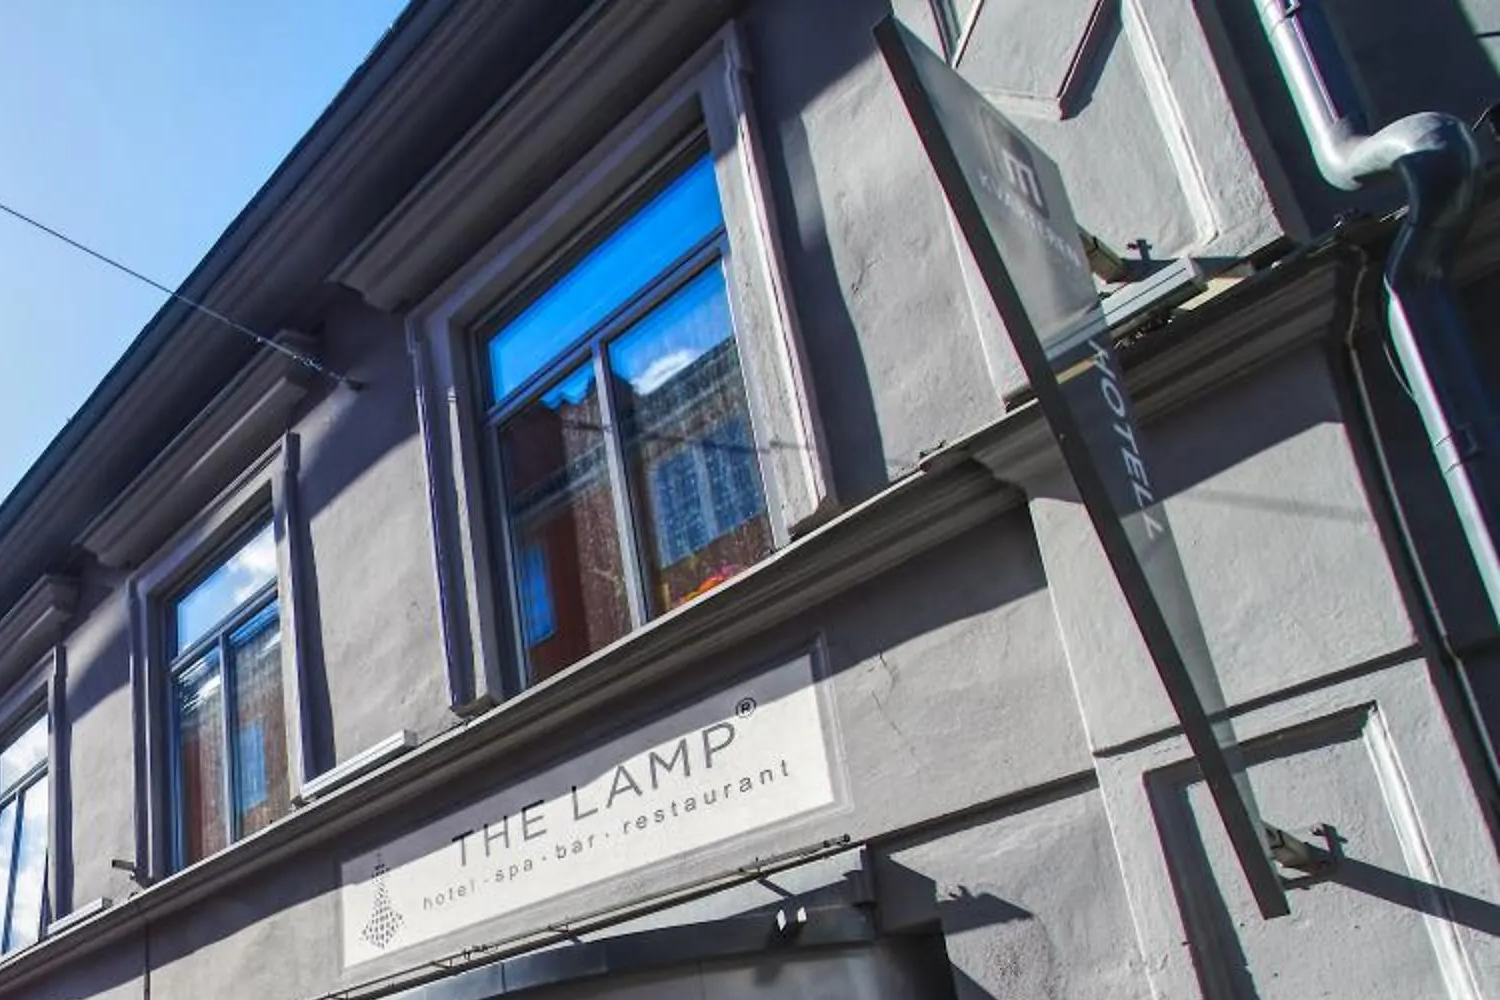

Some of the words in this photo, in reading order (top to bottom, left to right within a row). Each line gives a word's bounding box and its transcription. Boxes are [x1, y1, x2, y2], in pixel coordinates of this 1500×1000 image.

[422, 879, 477, 911] hotel
[494, 857, 534, 883] spa
[555, 834, 596, 861] bar
[622, 758, 790, 835] restaurant
[451, 798, 548, 867] THE
